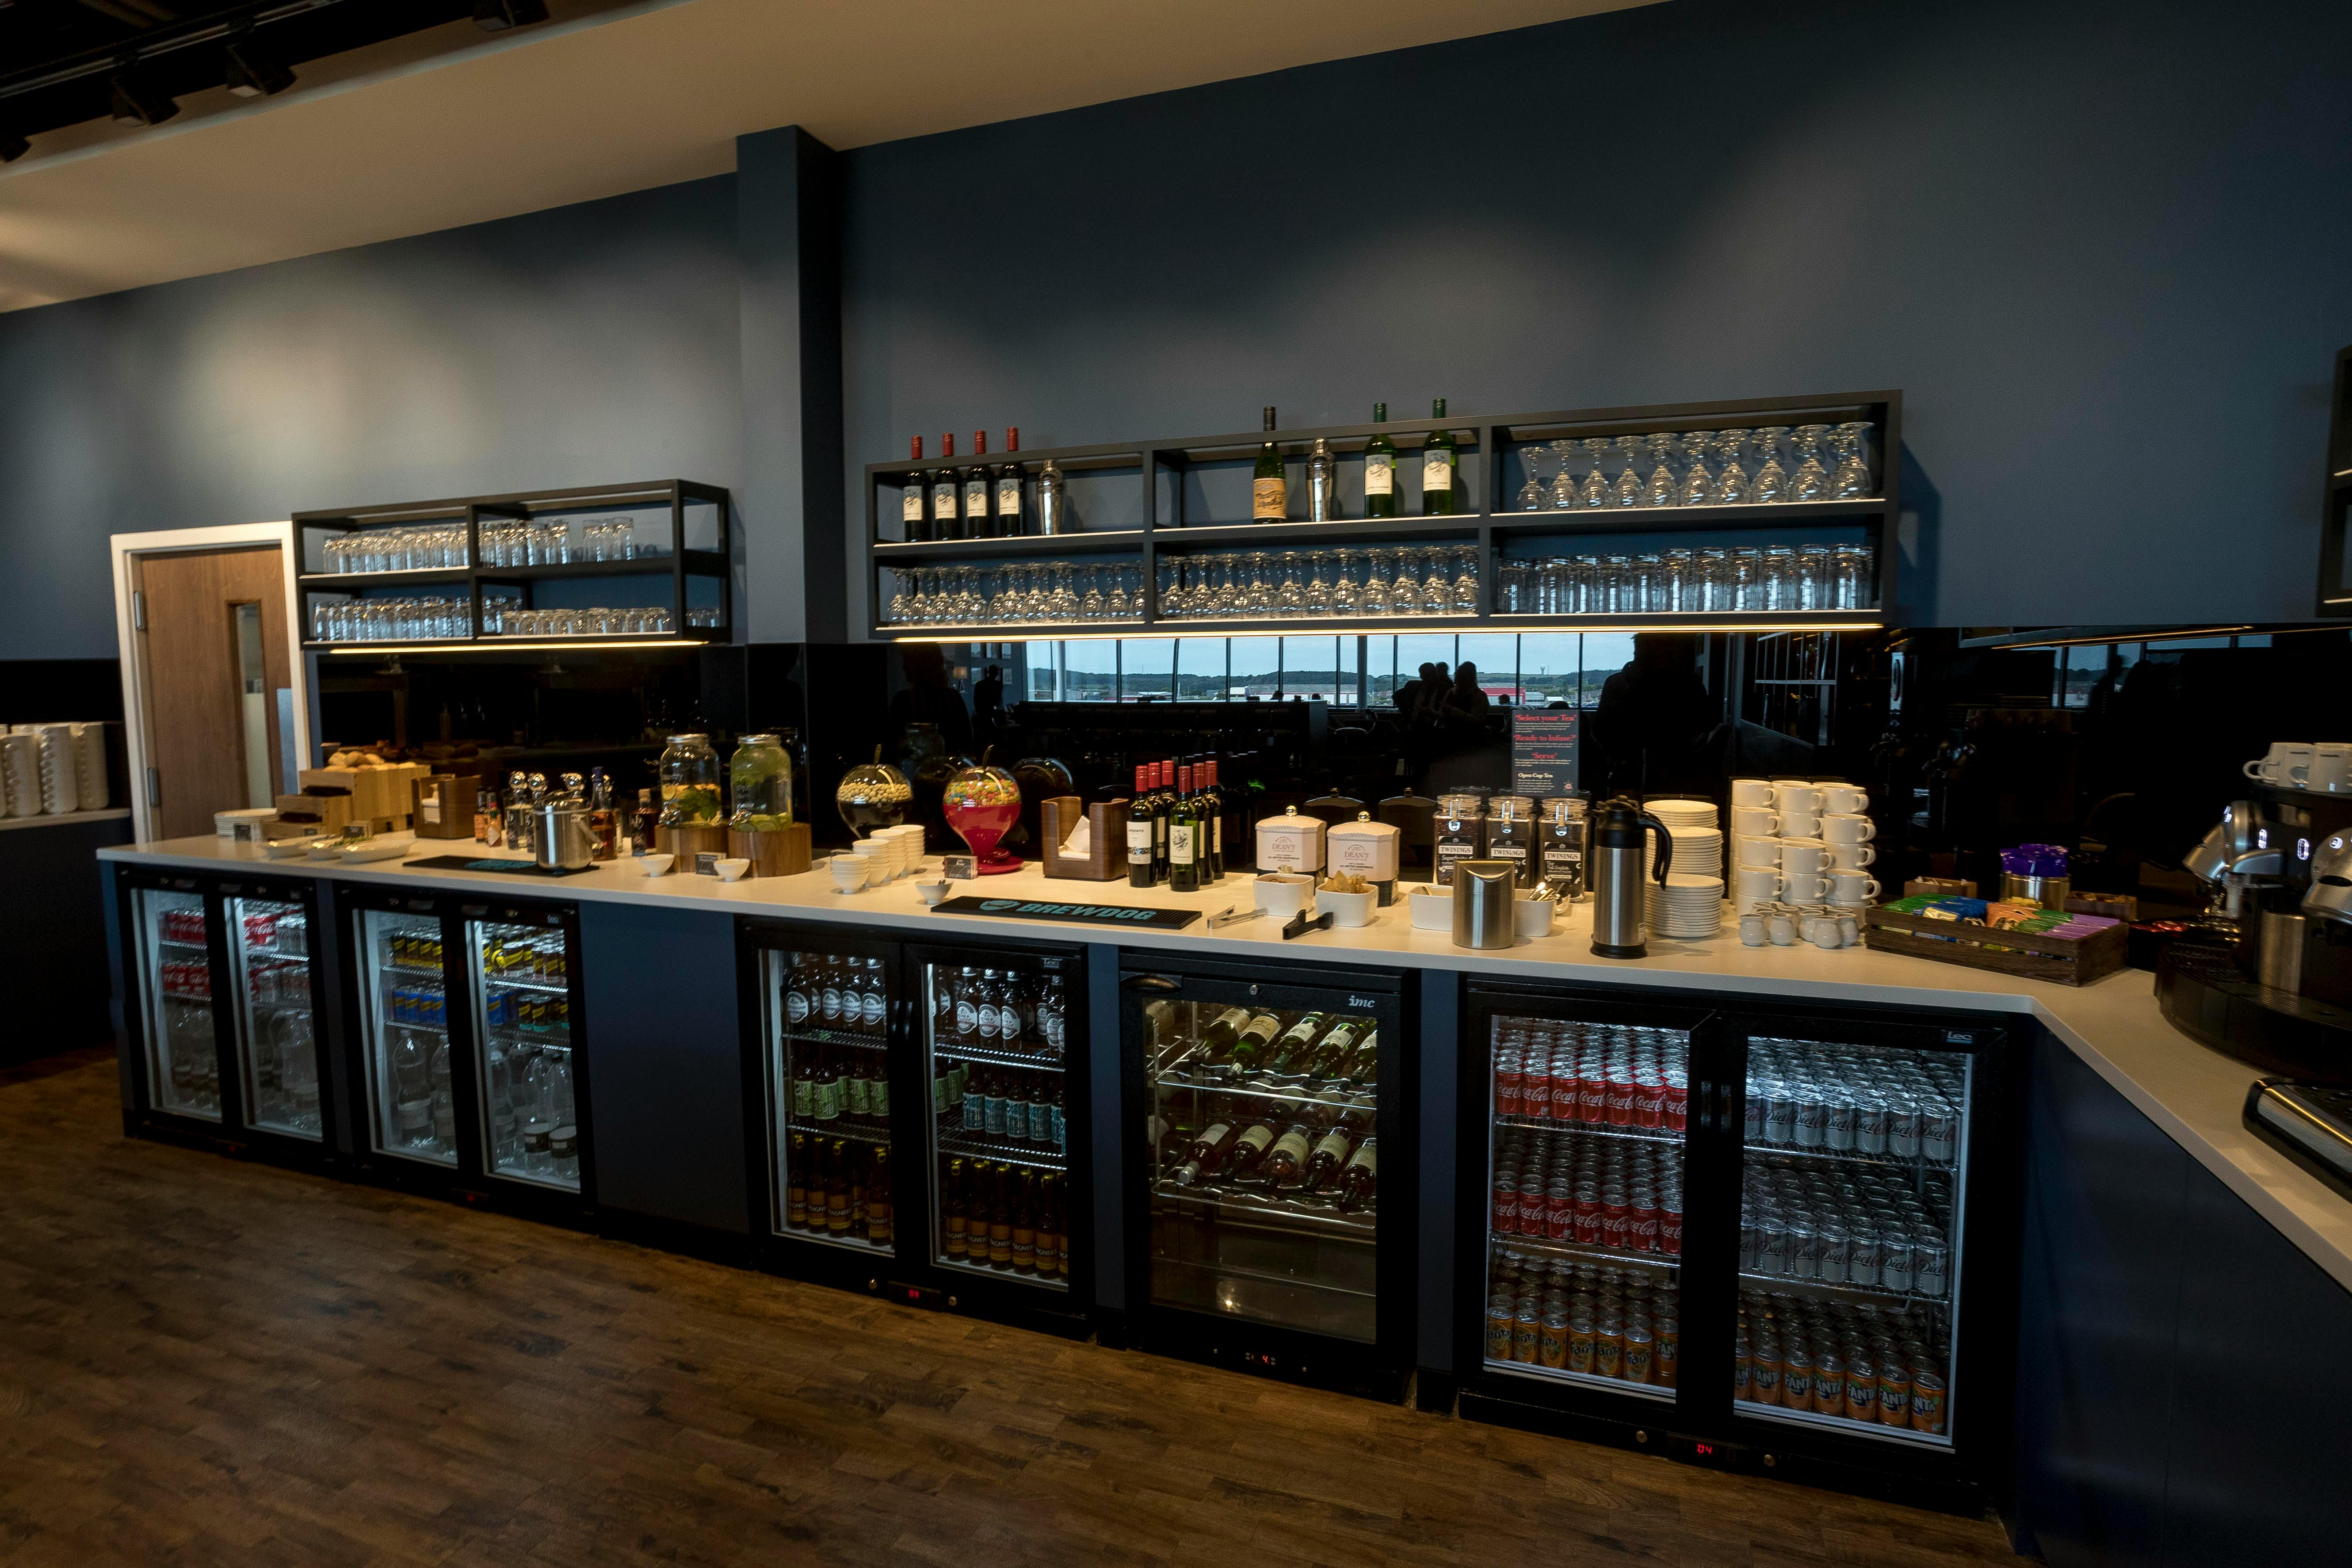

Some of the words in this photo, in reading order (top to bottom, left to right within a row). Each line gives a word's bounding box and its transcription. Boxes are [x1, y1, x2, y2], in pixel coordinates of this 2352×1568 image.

[1016, 904, 1157, 920] BREWDOG
[1348, 995, 1375, 1008] imc
[1947, 1031, 1973, 1040] Lec
[1764, 1109, 1787, 1123] Diet
[1825, 1114, 1847, 1128] Diet
[1923, 1123, 1945, 1138] Diet
[1761, 1240, 1783, 1255] Diet
[1919, 1260, 1943, 1273] Diet
[1488, 1328, 1510, 1339] anta
[1514, 1332, 1537, 1343] anta
[1697, 1444, 1712, 1455] 04
